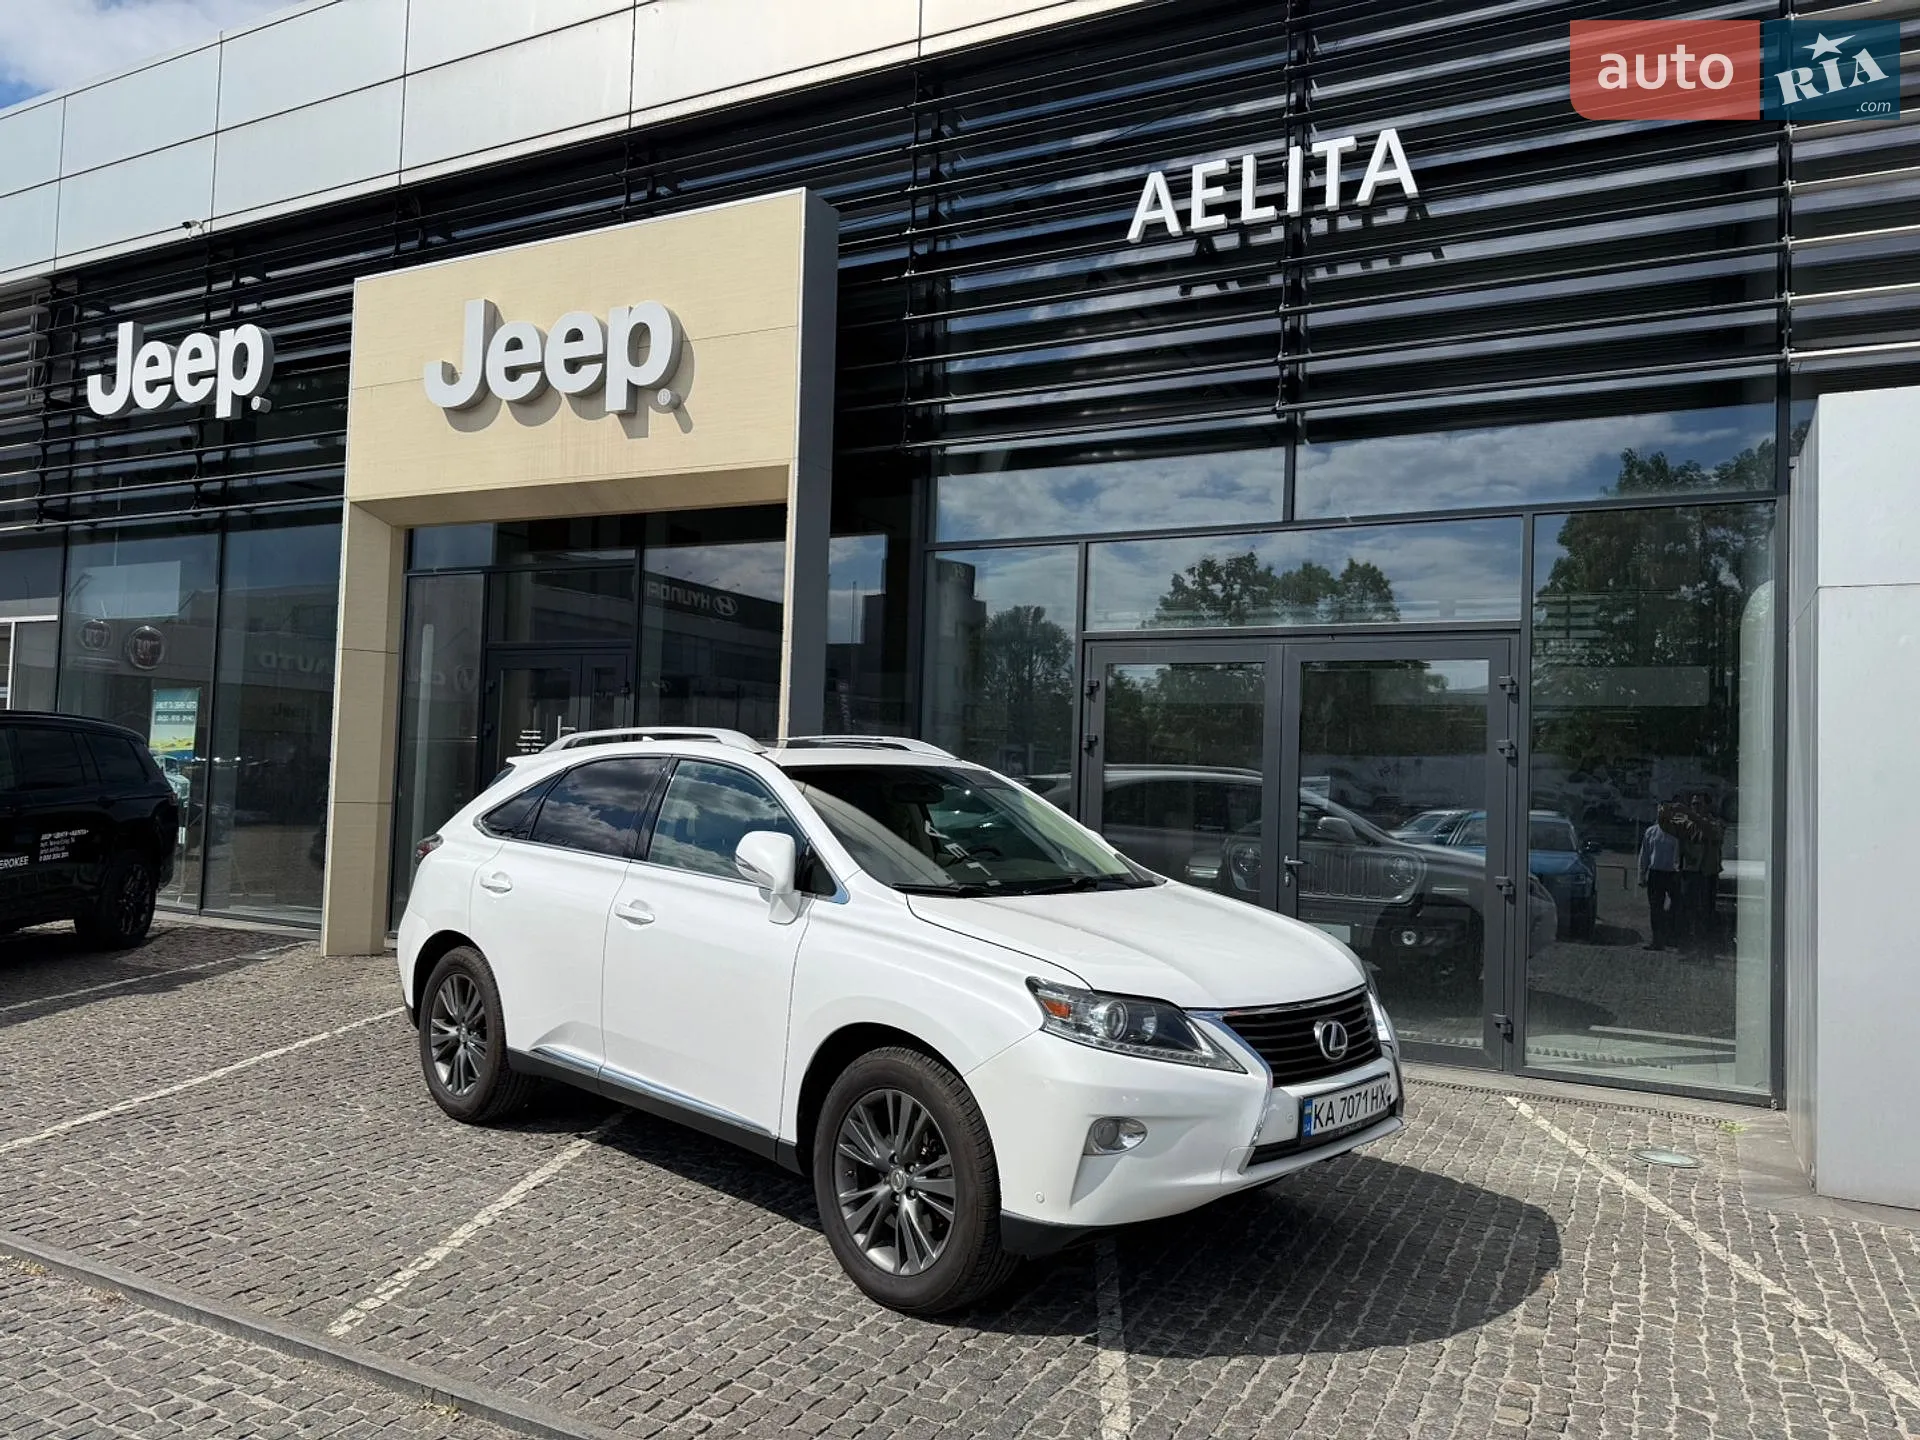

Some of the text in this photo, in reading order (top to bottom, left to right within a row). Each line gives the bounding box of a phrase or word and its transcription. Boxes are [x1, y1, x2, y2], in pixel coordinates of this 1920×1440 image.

[1126, 128, 1418, 243] AELITA
[1313, 1101, 1335, 1130] KA
[1340, 1090, 1368, 1122] 7071
[1371, 1084, 1387, 1112] HX
